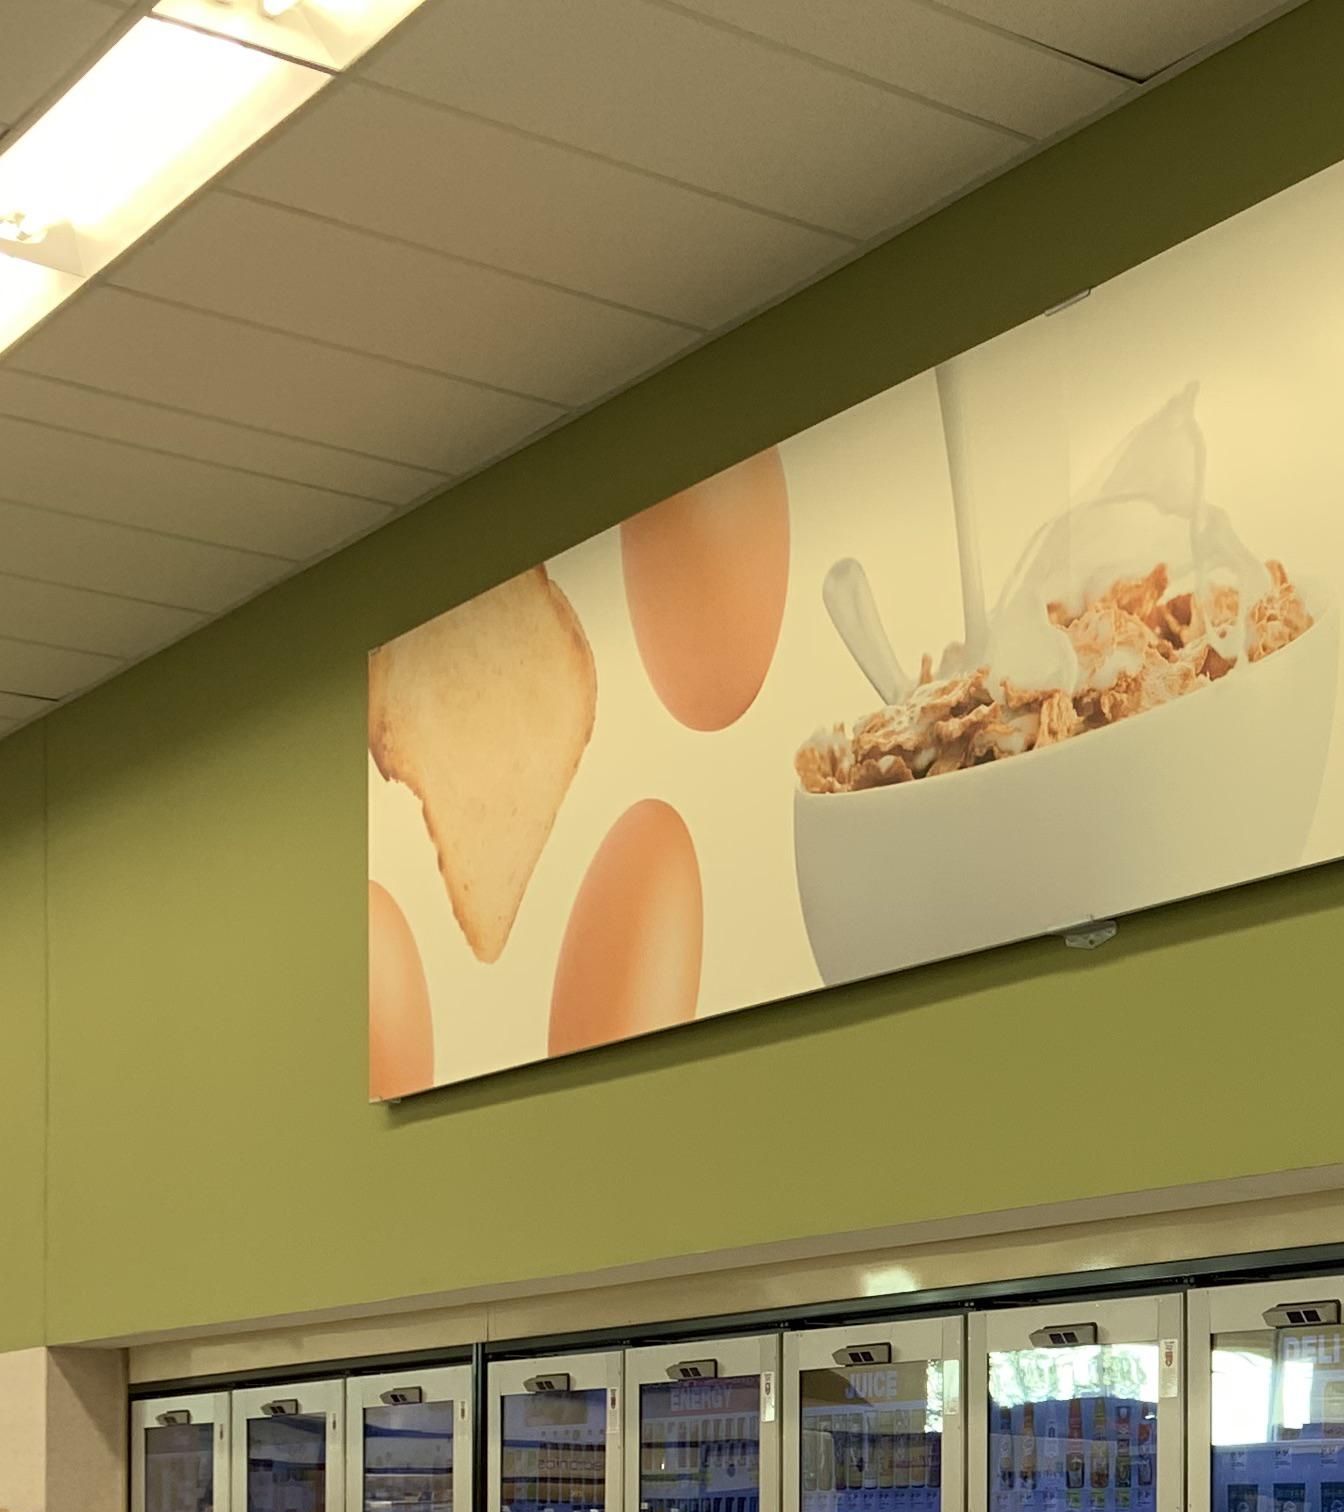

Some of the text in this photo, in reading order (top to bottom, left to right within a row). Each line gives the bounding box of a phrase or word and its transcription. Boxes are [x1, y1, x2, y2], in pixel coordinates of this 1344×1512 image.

[1283, 1333, 1341, 1363] DELI
[671, 1384, 732, 1411] ENERGY
[844, 1370, 897, 1399] JUICE
